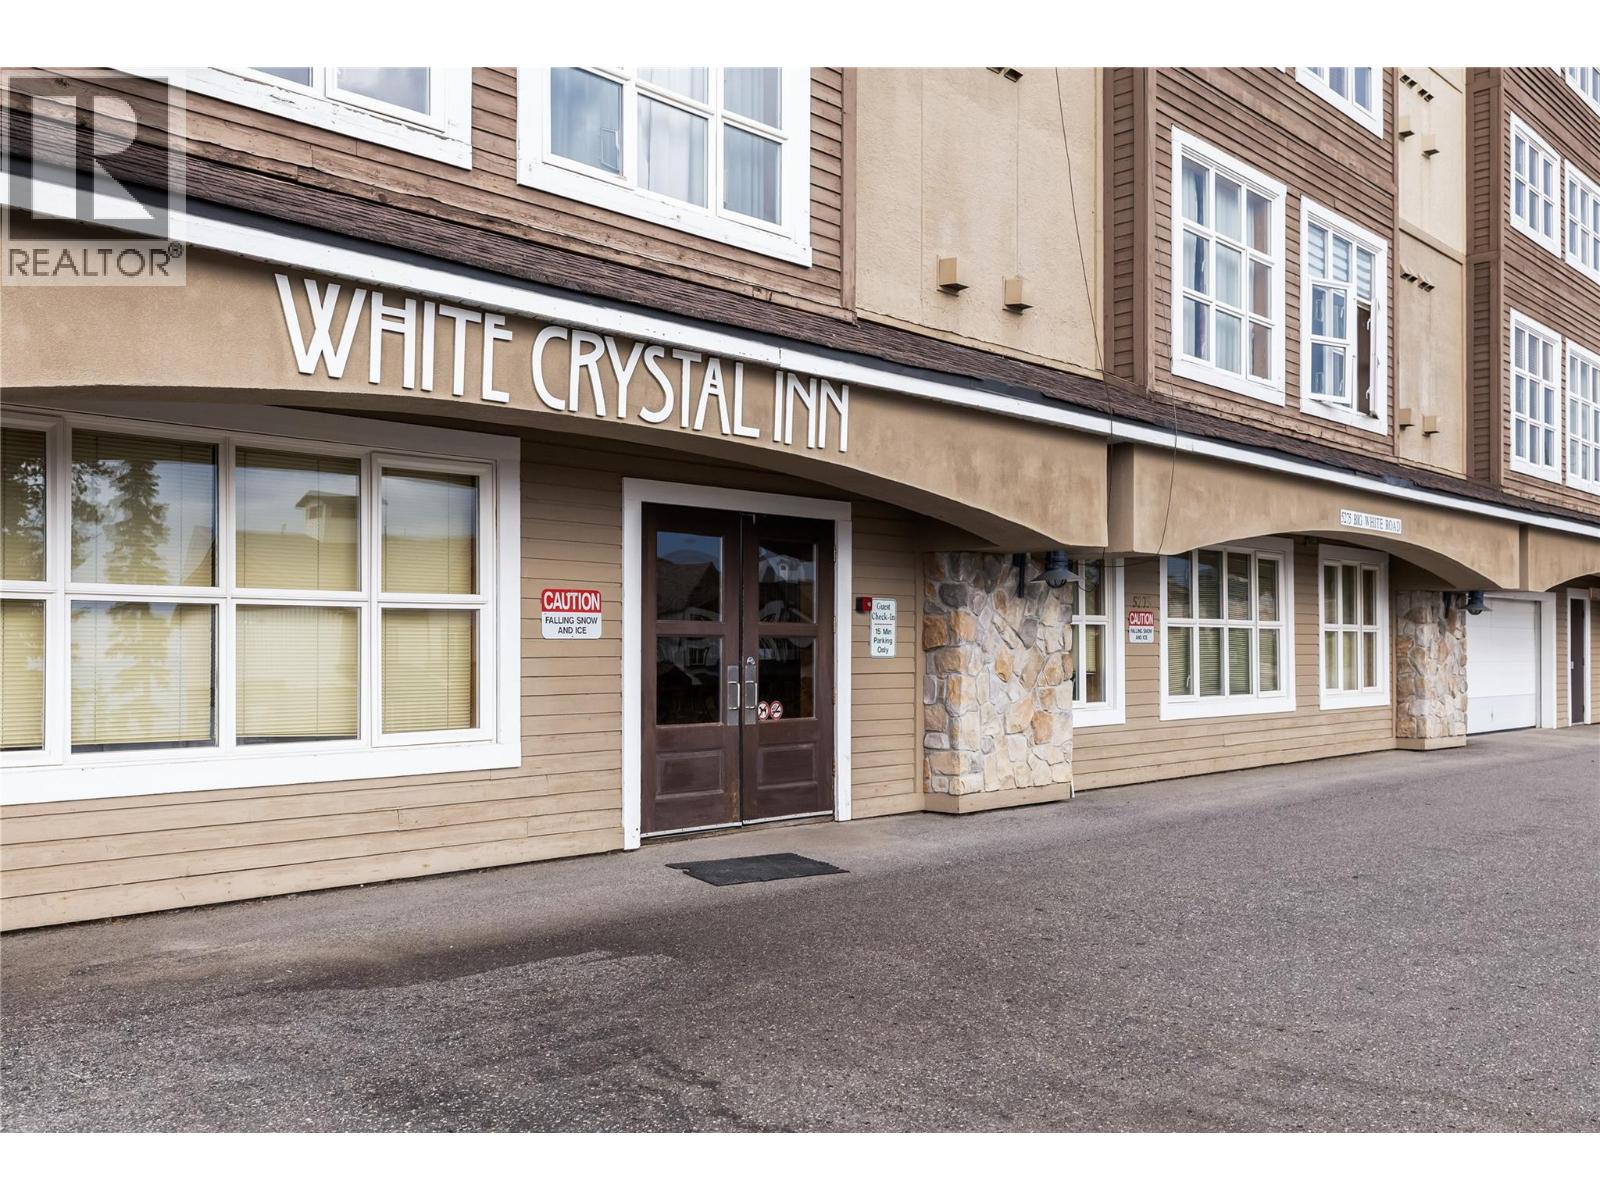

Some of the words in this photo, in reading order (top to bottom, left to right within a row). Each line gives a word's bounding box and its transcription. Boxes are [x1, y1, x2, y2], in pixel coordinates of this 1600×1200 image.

[274, 272, 513, 405] WHITE
[531, 325, 760, 440] CRYSTAL
[772, 370, 850, 453] INN
[1353, 513, 1363, 526] BIG
[1364, 515, 1384, 530] WHITE
[1385, 519, 1401, 532] ROAD
[543, 591, 601, 611] CAUTION
[876, 602, 891, 610] Guest
[545, 616, 575, 625] FALLING
[576, 616, 598, 625] SNOW
[872, 612, 896, 621] Check-In
[1129, 612, 1154, 625] CAUTION
[558, 626, 573, 634] AND
[575, 626, 587, 635] ICE
[873, 636, 893, 645] Parking
[877, 646, 889, 655] Only
